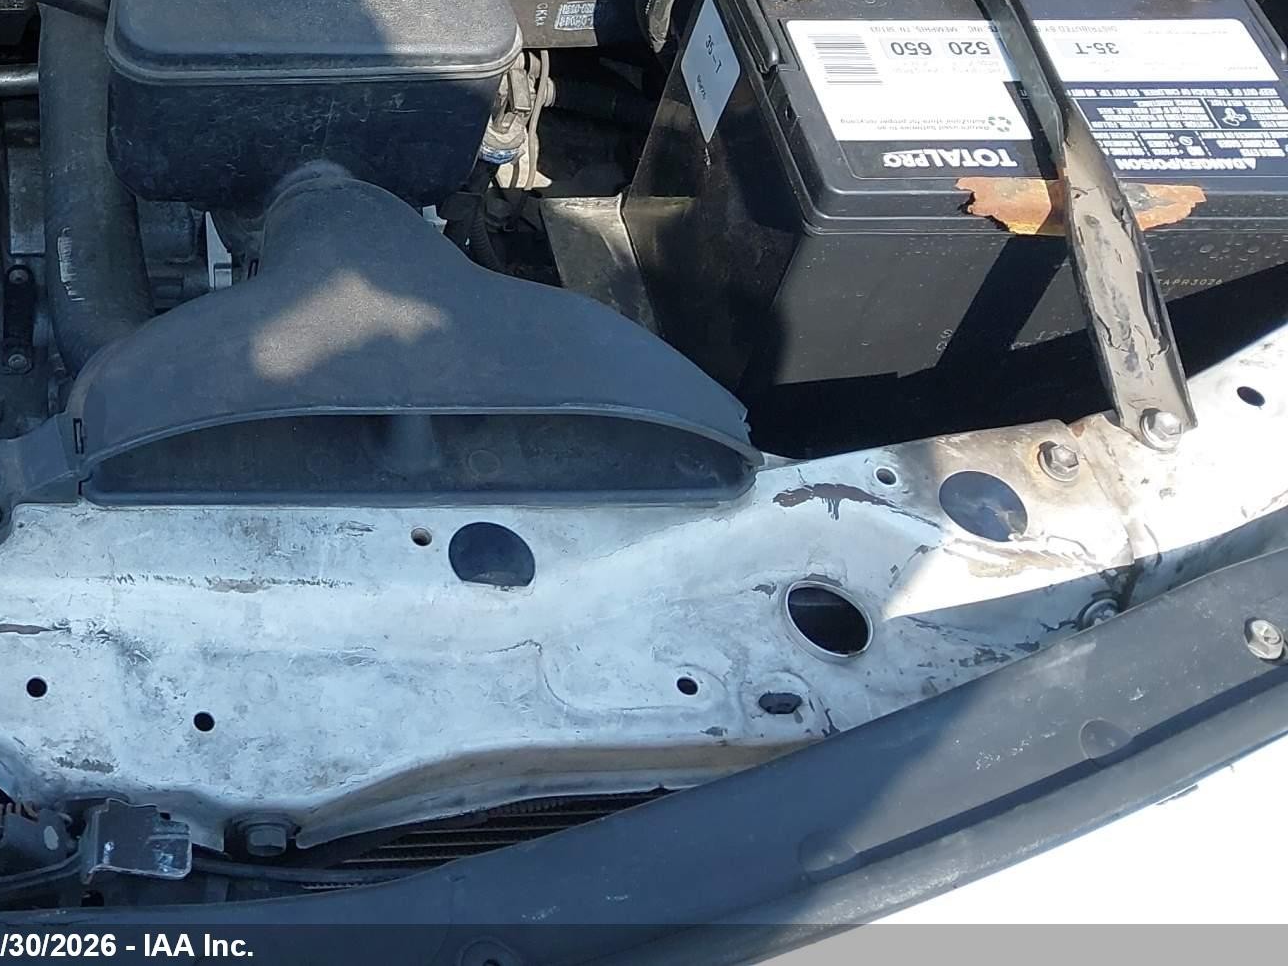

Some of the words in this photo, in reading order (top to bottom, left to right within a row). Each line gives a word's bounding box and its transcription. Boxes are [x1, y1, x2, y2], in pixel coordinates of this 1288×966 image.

[890, 41, 932, 55] 650
[948, 41, 990, 55] 520
[1072, 42, 1120, 55] 35-T
